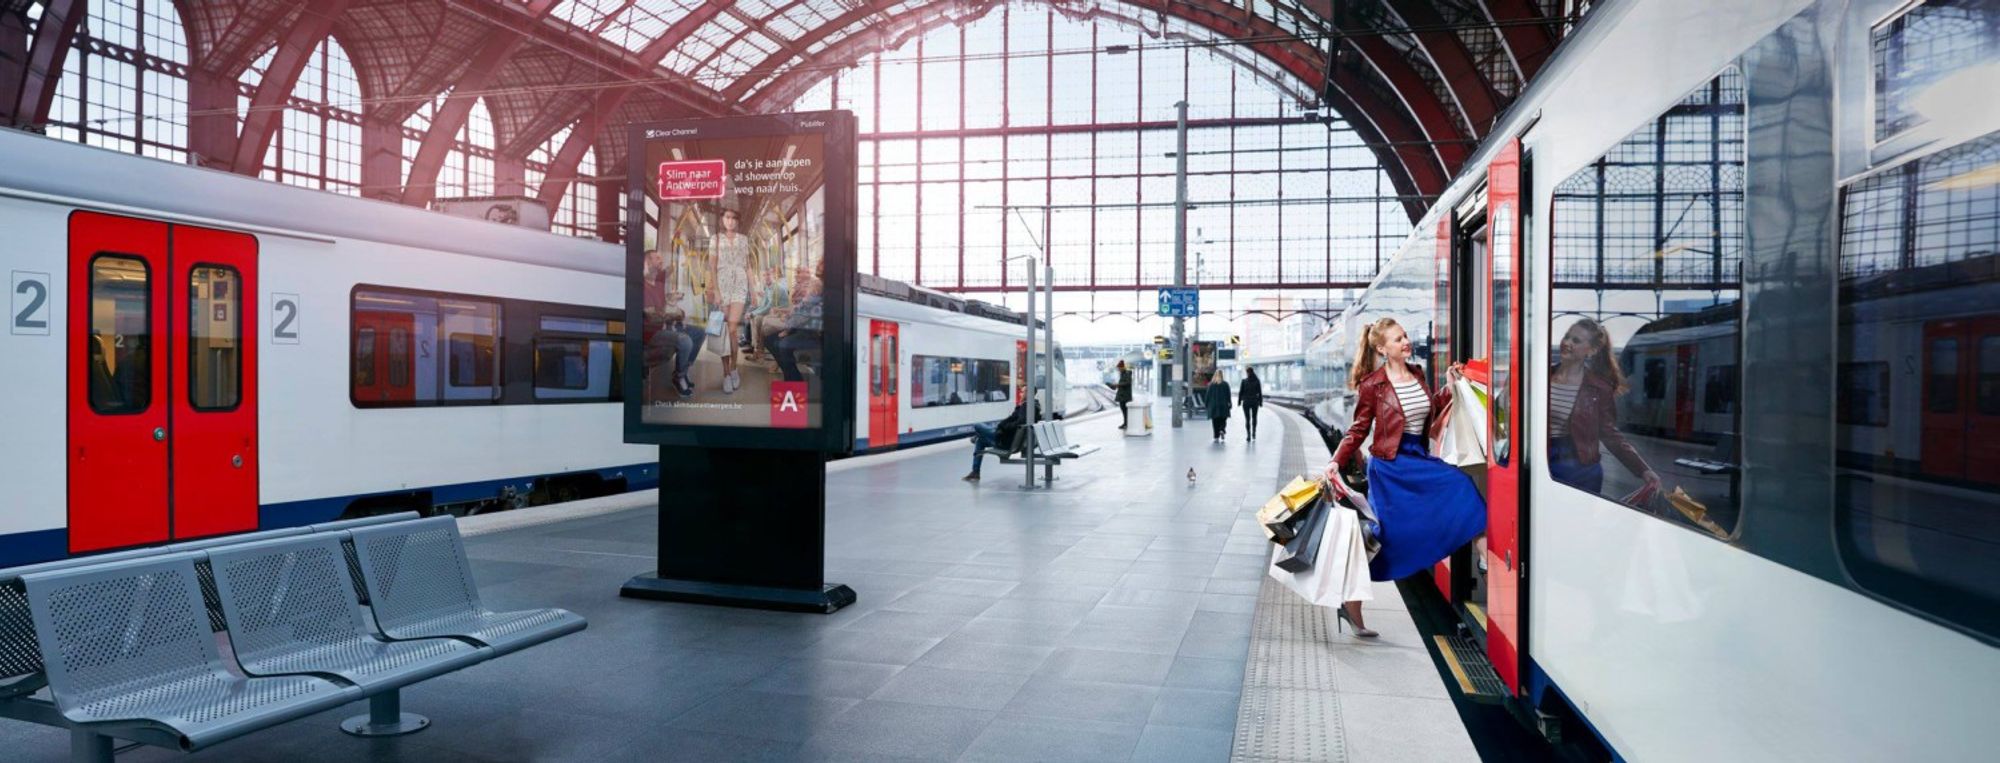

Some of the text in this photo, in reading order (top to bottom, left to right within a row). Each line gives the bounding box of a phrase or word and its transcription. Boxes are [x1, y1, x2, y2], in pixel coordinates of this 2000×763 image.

[671, 128, 698, 136] Channel
[734, 157, 811, 169] da's je aankopen
[666, 169, 711, 180] Slim naar
[734, 171, 796, 182] al showen op
[666, 180, 718, 191] Antwerpen
[734, 185, 754, 195] weg
[756, 182, 777, 193] naar
[15, 279, 47, 328] 2
[274, 300, 297, 338] 2
[115, 334, 124, 348] 2
[780, 390, 798, 412] A
